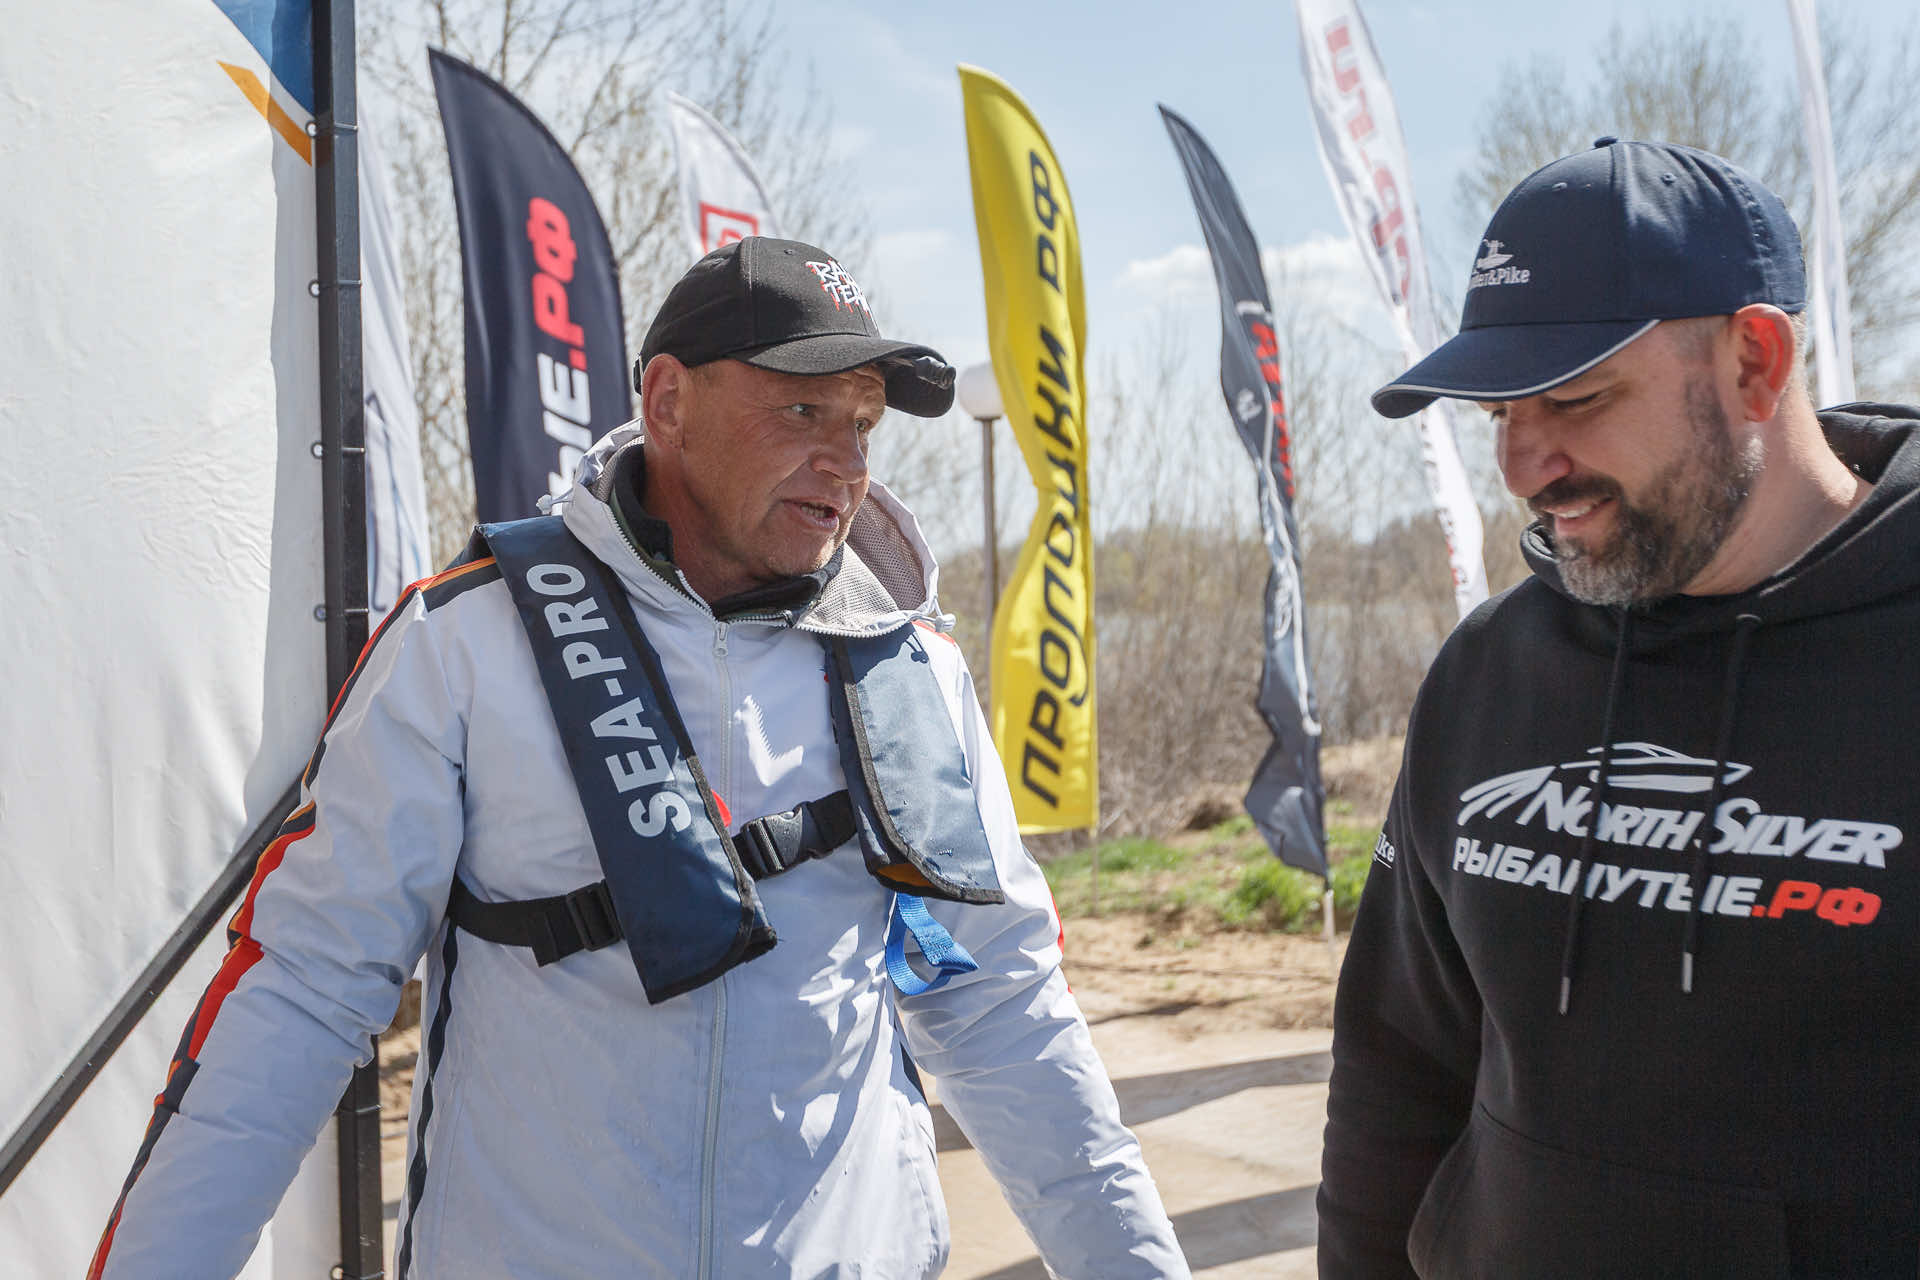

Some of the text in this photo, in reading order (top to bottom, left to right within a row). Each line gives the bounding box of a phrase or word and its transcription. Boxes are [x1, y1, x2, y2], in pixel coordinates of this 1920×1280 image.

[525, 562, 693, 838] SEA-PRO
[1515, 780, 1904, 869] NORTH SILVER
[1451, 835, 1882, 927] РЫБАНУТЫЕ.РФ
